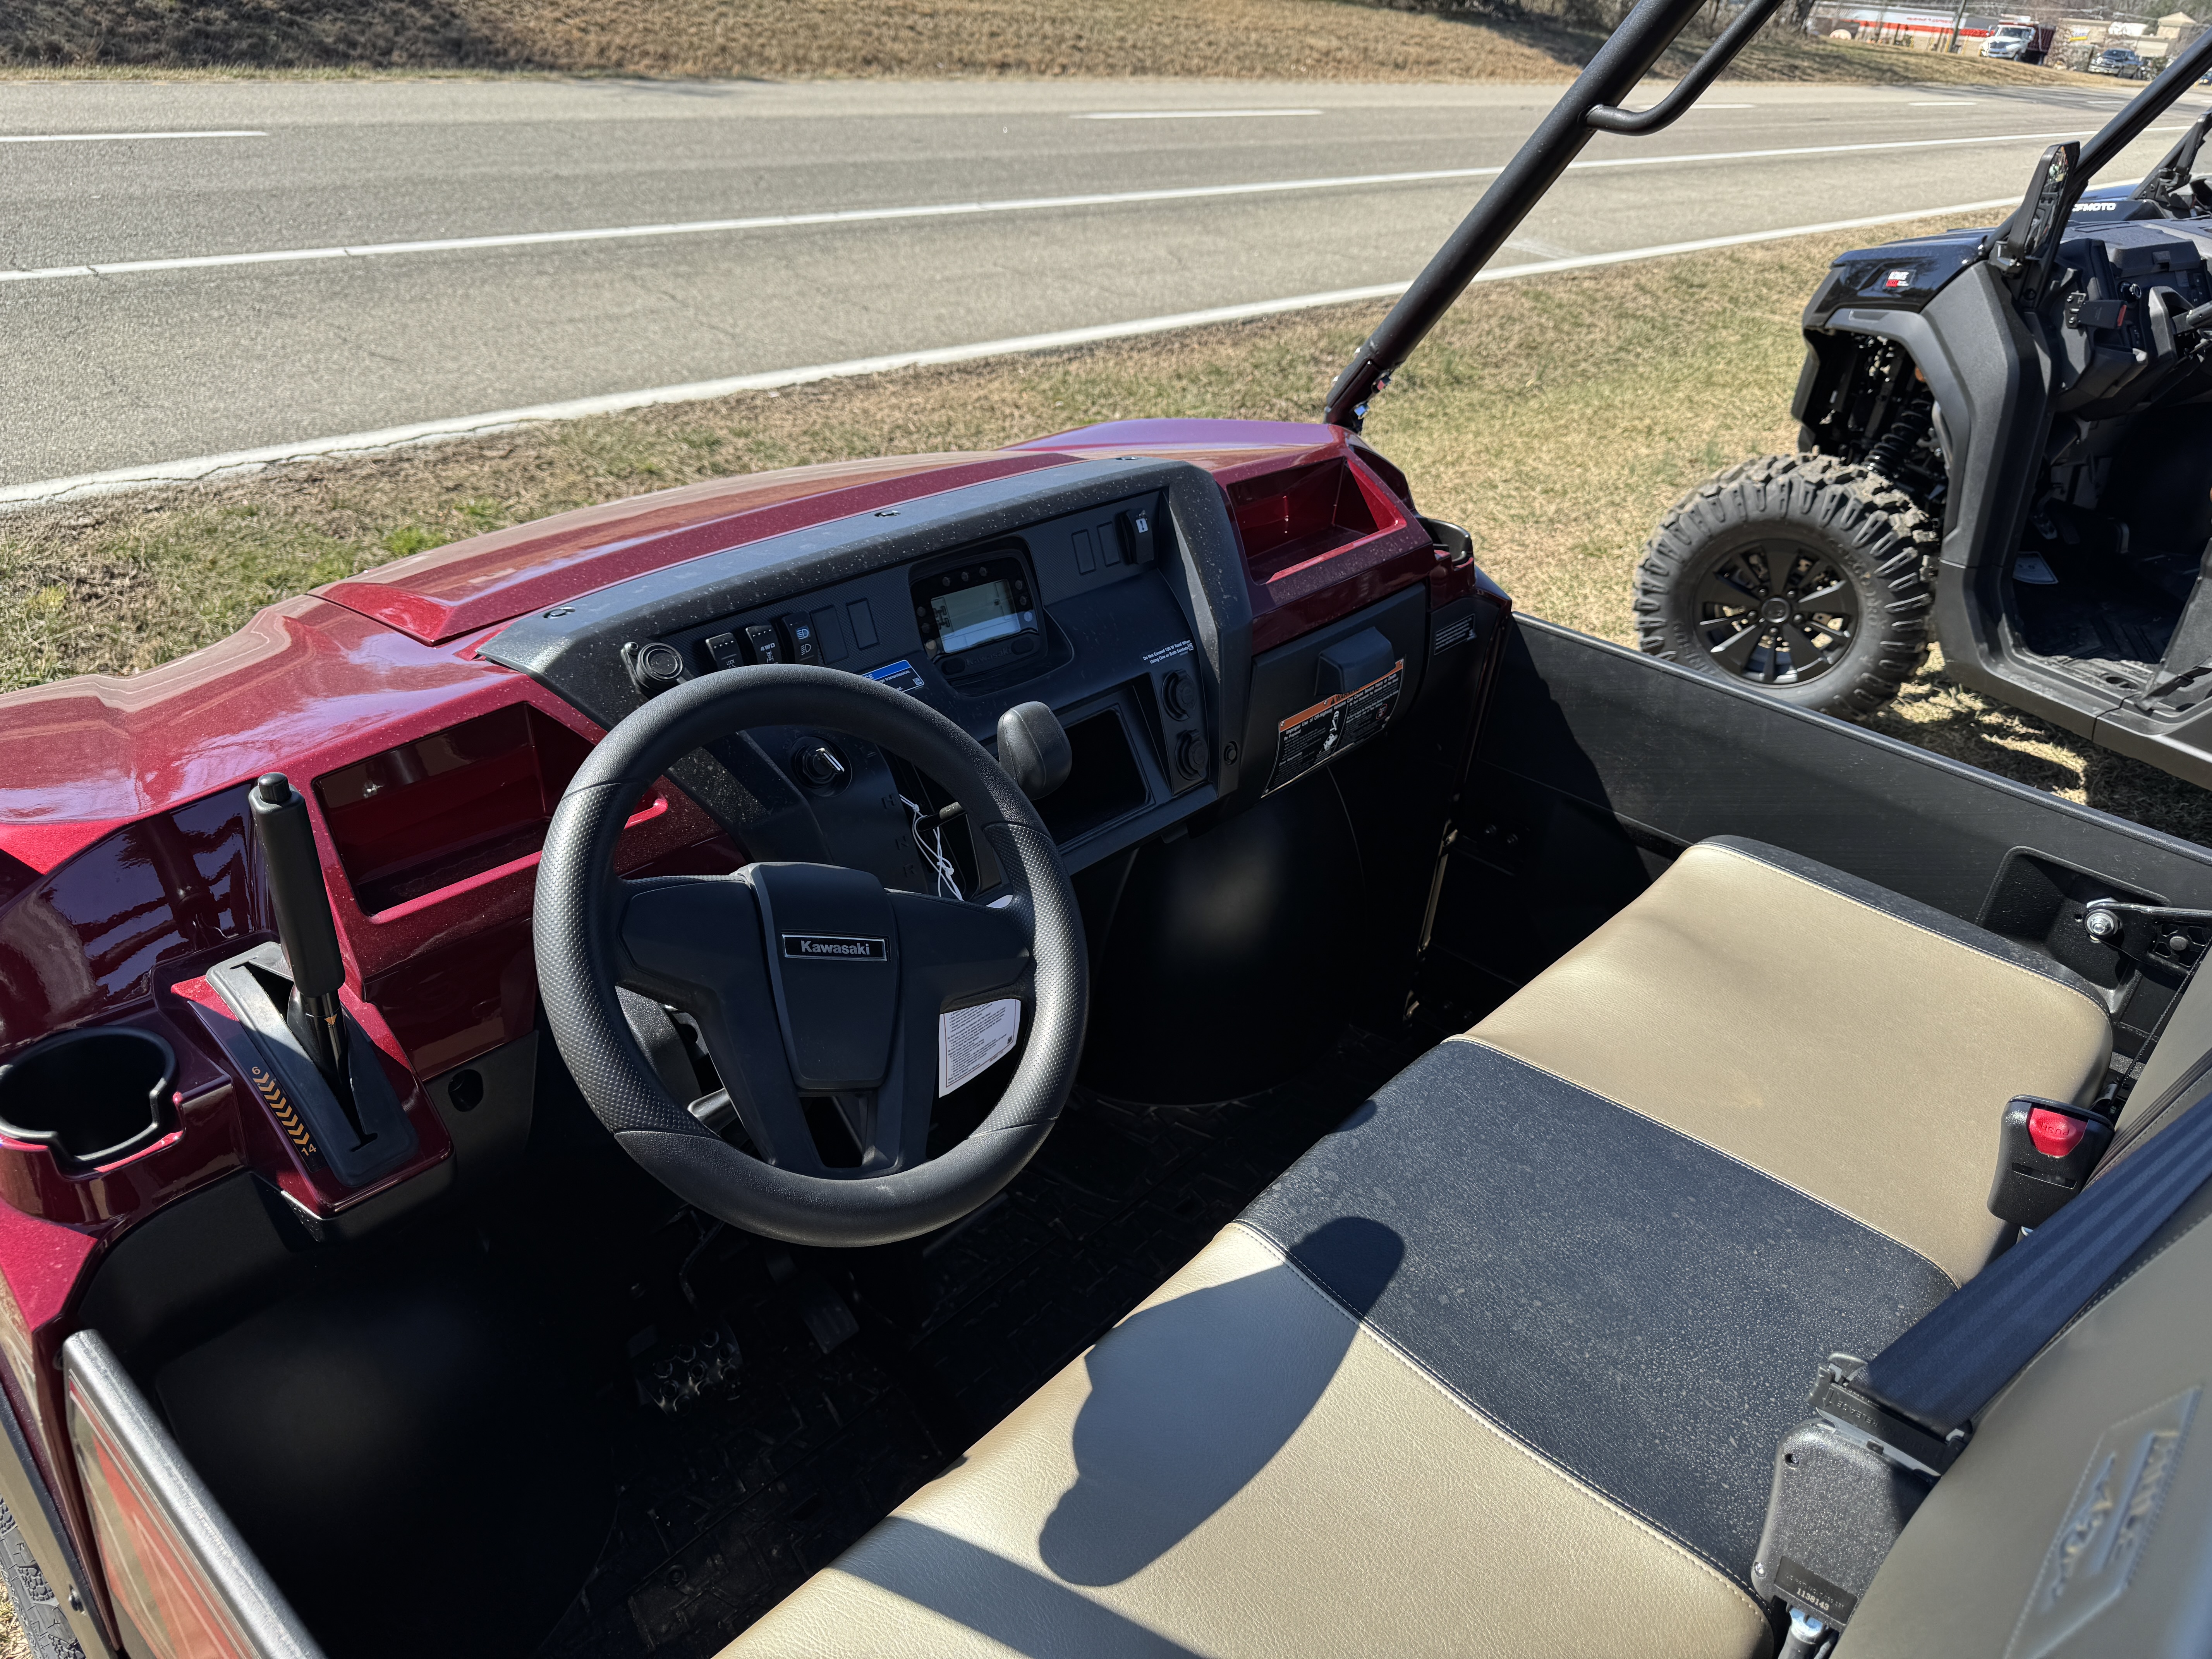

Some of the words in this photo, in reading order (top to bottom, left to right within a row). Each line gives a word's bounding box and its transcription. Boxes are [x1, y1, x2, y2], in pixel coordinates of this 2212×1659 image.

[761, 642, 775, 651] 4WD
[965, 646, 1012, 666] Kawasaki
[884, 670, 911, 681] transmission.
[1286, 724, 1301, 735] Improper
[1314, 708, 1333, 720] Off-Highway
[881, 794, 895, 809] H
[801, 940, 870, 955] Kawasaki
[252, 1066, 261, 1075] 6
[2040, 1121, 2070, 1135] PUSH
[301, 1144, 316, 1156] 14
[1837, 1400, 1878, 1427] RELEASE
[1796, 1588, 1830, 1611] 1138143
